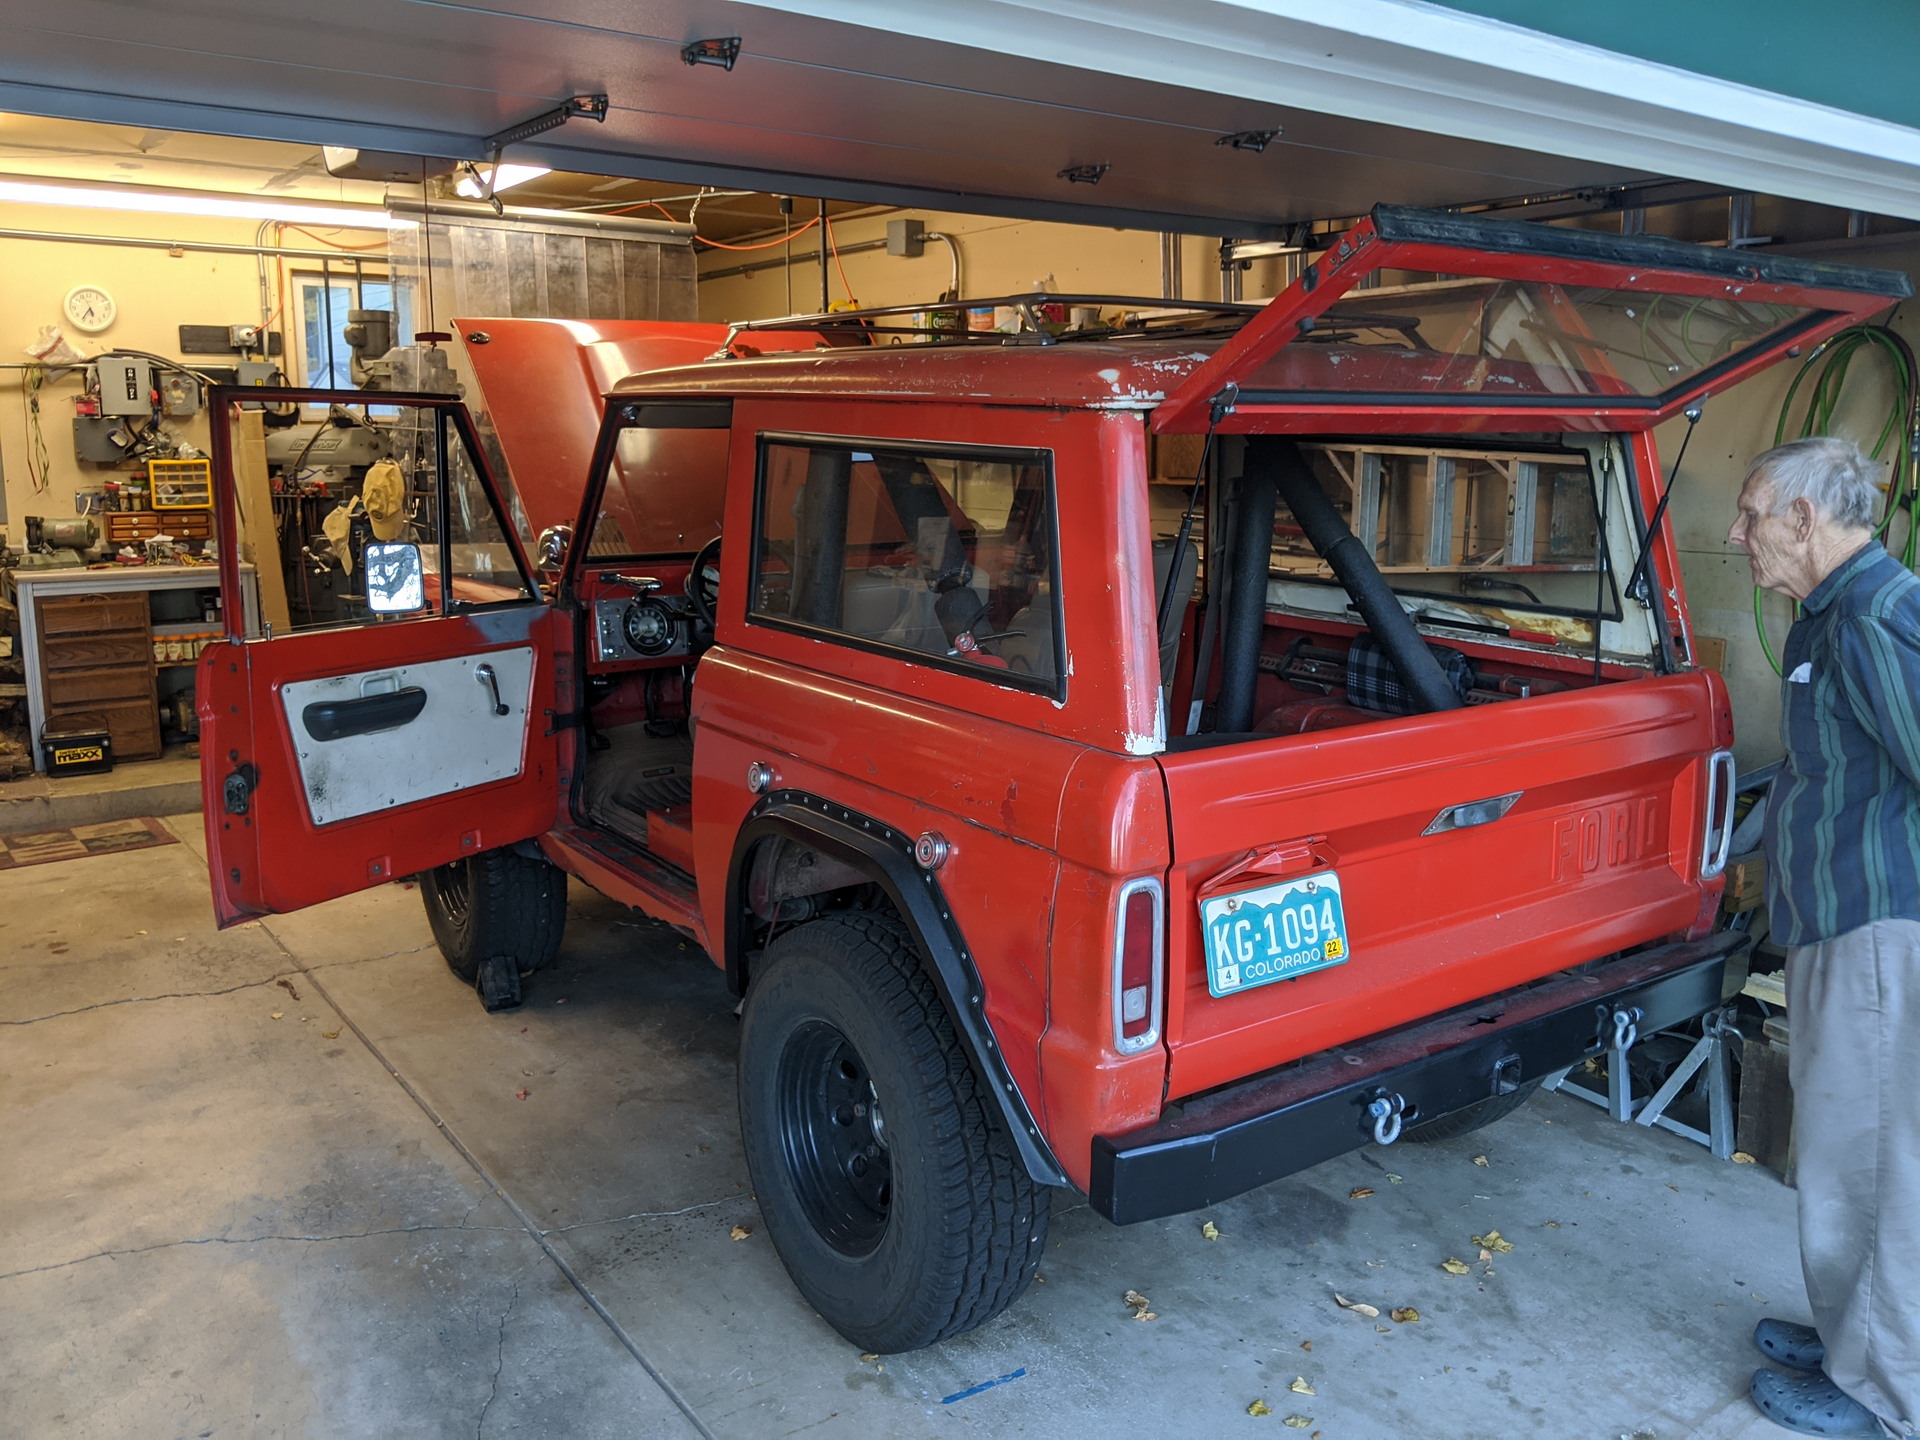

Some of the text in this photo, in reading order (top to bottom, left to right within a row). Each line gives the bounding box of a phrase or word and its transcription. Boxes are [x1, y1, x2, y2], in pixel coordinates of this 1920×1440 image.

[57, 749, 101, 763] maxx
[1550, 796, 1659, 882] FORD
[1326, 941, 1338, 954] 22
[1245, 948, 1321, 979] COLORADO
